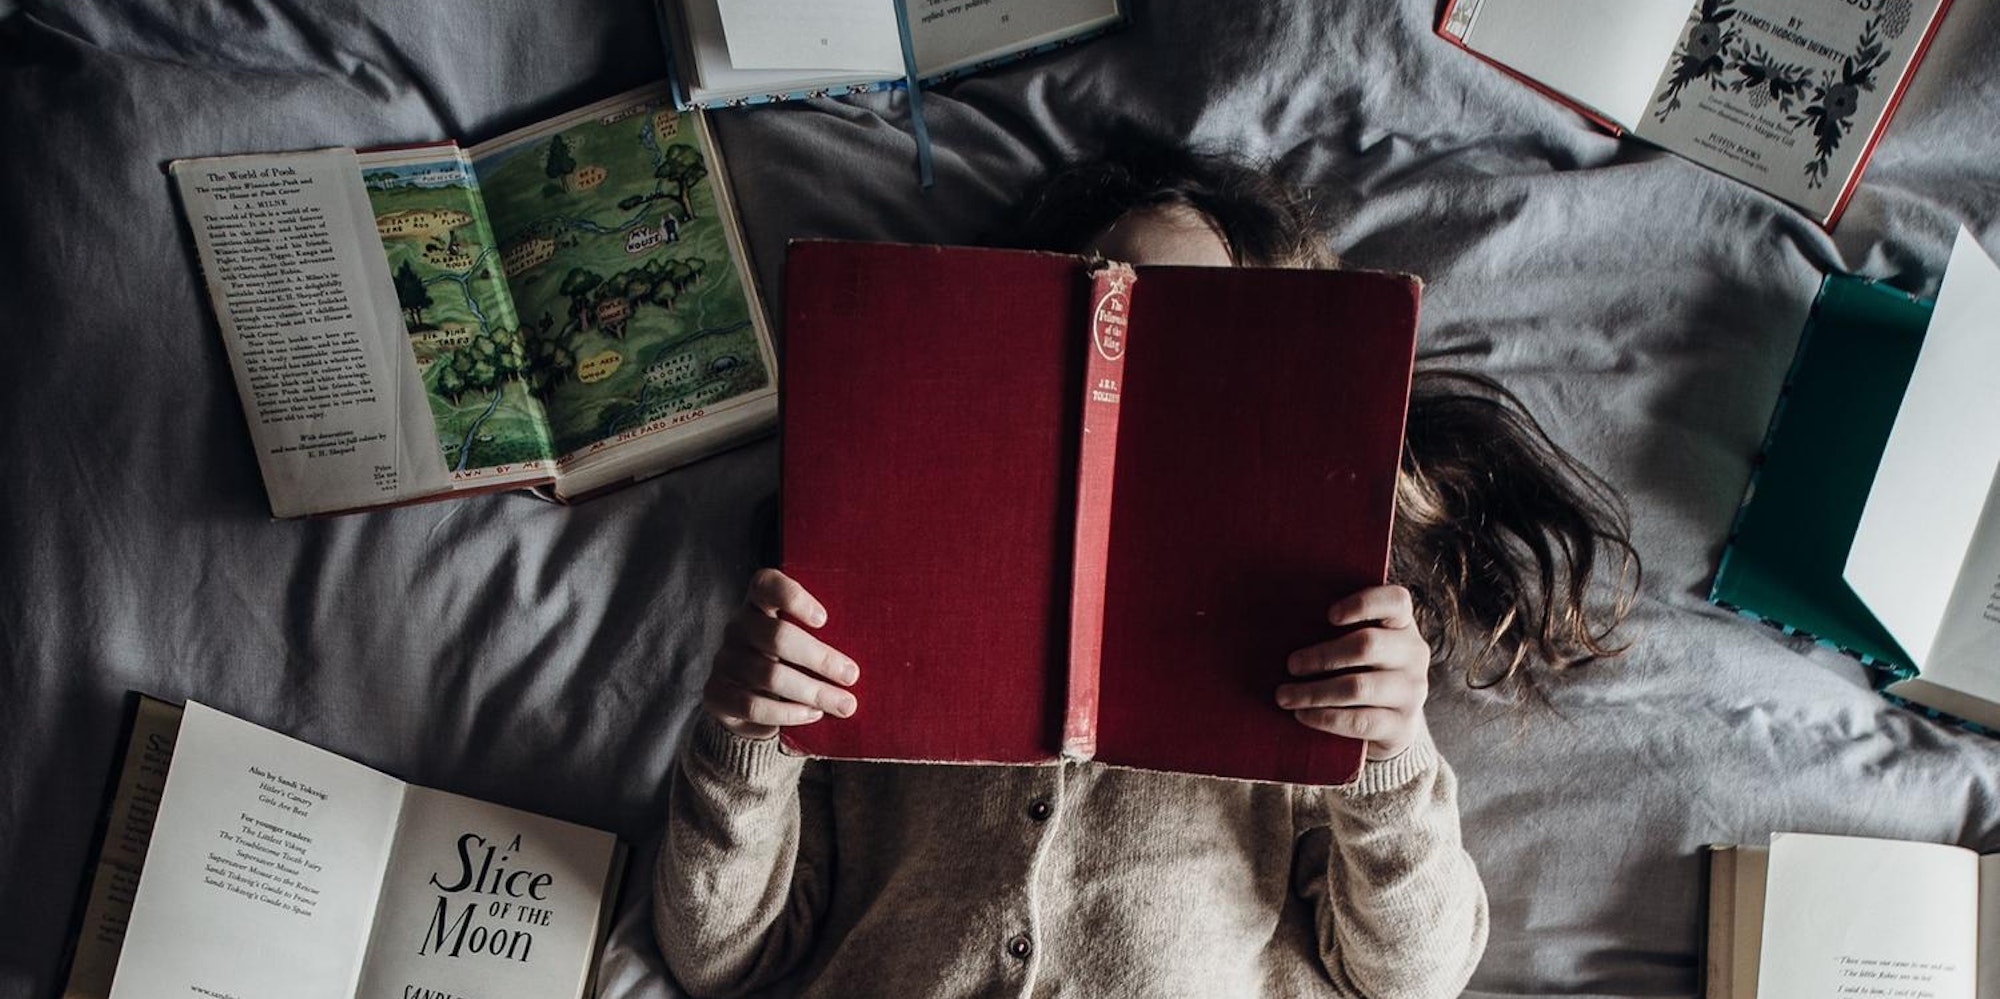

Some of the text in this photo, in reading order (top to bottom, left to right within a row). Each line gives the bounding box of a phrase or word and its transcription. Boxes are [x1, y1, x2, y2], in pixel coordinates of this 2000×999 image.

[922, 9, 944, 24] replied
[1788, 16, 1803, 30] BY
[1735, 10, 1846, 63] FRANCES HODGSON BURNETT
[1754, 124, 1780, 142] Margery
[1708, 132, 1735, 150] PUFFIN
[1736, 144, 1760, 160] BOOKS
[206, 165, 296, 182] The World of Pooh
[257, 198, 288, 208] MILNE
[632, 228, 649, 239] MY
[1110, 298, 1124, 312] The
[1104, 324, 1122, 337] of the
[1103, 336, 1120, 353] Ring
[663, 369, 696, 386] PLACE
[496, 465, 512, 474] BY
[523, 462, 542, 470] ME
[616, 421, 666, 443] SHEPARD
[373, 463, 393, 472] Price
[248, 766, 328, 800] Also by Sandi Toksvig:
[258, 782, 312, 808] Hitler's Canary
[258, 794, 308, 818] Girls Are Best
[240, 812, 312, 843] For younger readers:
[220, 830, 322, 872] The Troublesome Tooth Fairy
[242, 826, 307, 856] The Littlest Viking
[508, 834, 522, 852] A
[208, 852, 248, 869] Supersaver
[248, 866, 274, 879] Mouse
[282, 878, 294, 886] the
[296, 882, 320, 894] Rescue
[236, 849, 300, 875] Supersaver Mouse
[429, 834, 552, 900] Slice
[204, 876, 312, 916] Sandi Toksvig's Guide to Spain
[205, 864, 226, 876] Sandi
[228, 870, 260, 888] Toksvig's
[260, 882, 282, 895] Guide
[292, 894, 317, 906] France
[489, 901, 554, 926] OF THE
[418, 895, 533, 962] Moon
